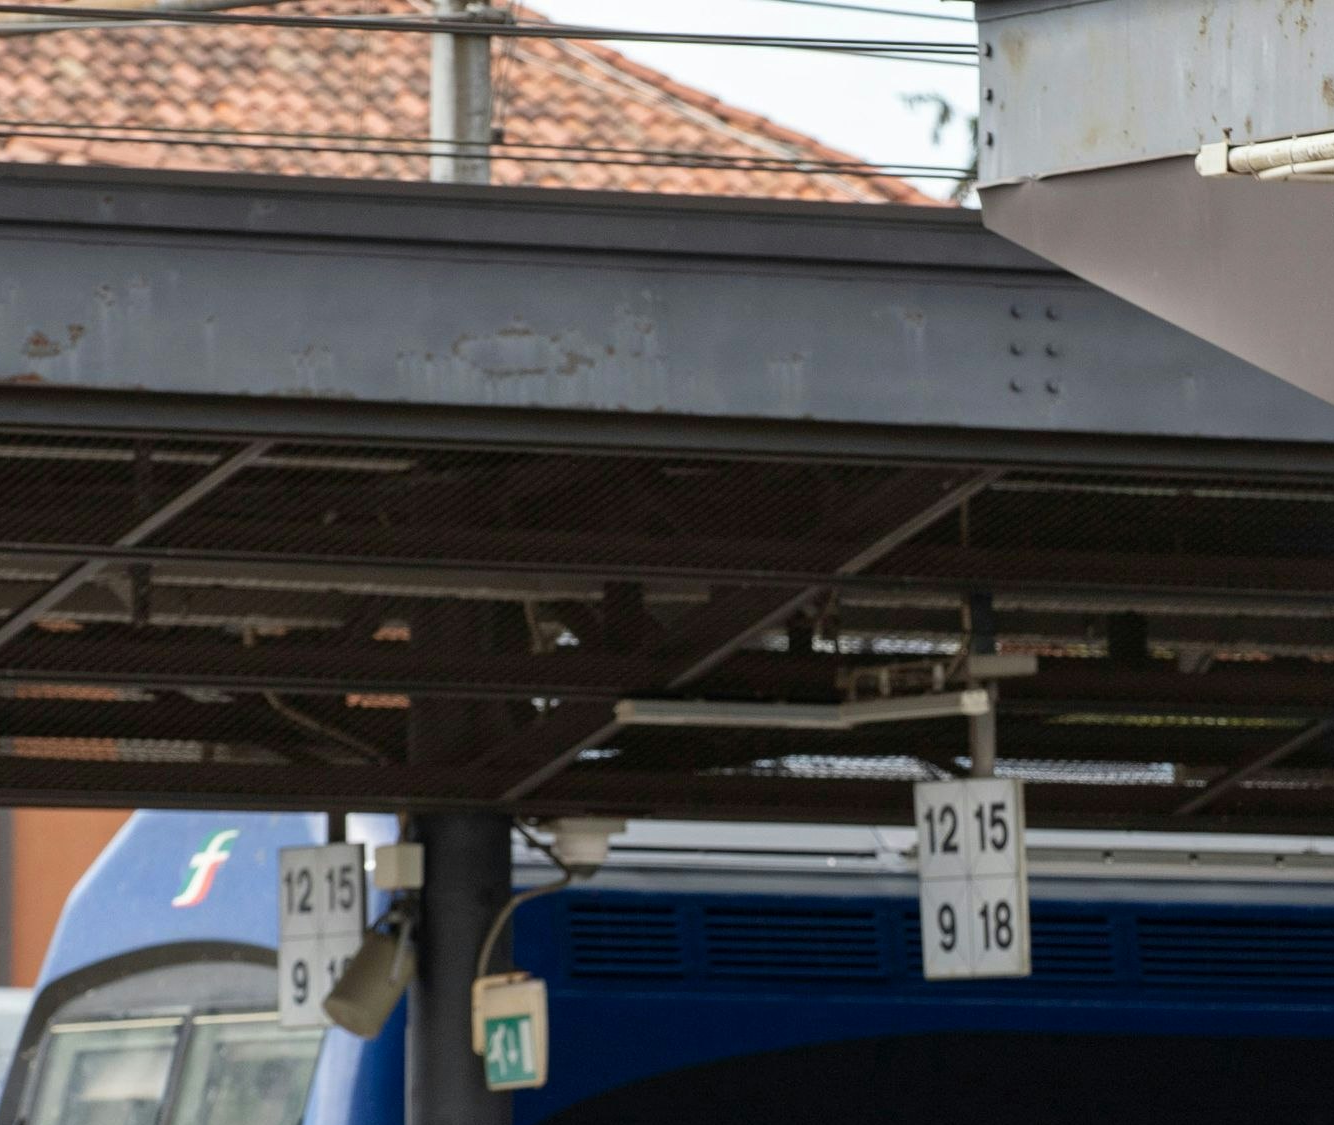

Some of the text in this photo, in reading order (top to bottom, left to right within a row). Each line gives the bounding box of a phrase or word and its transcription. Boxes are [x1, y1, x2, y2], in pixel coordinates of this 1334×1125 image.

[924, 801, 1008, 854] 12 15
[284, 864, 355, 914] 12 15
[937, 902, 1013, 952] 9 18
[292, 961, 309, 1004] 9
